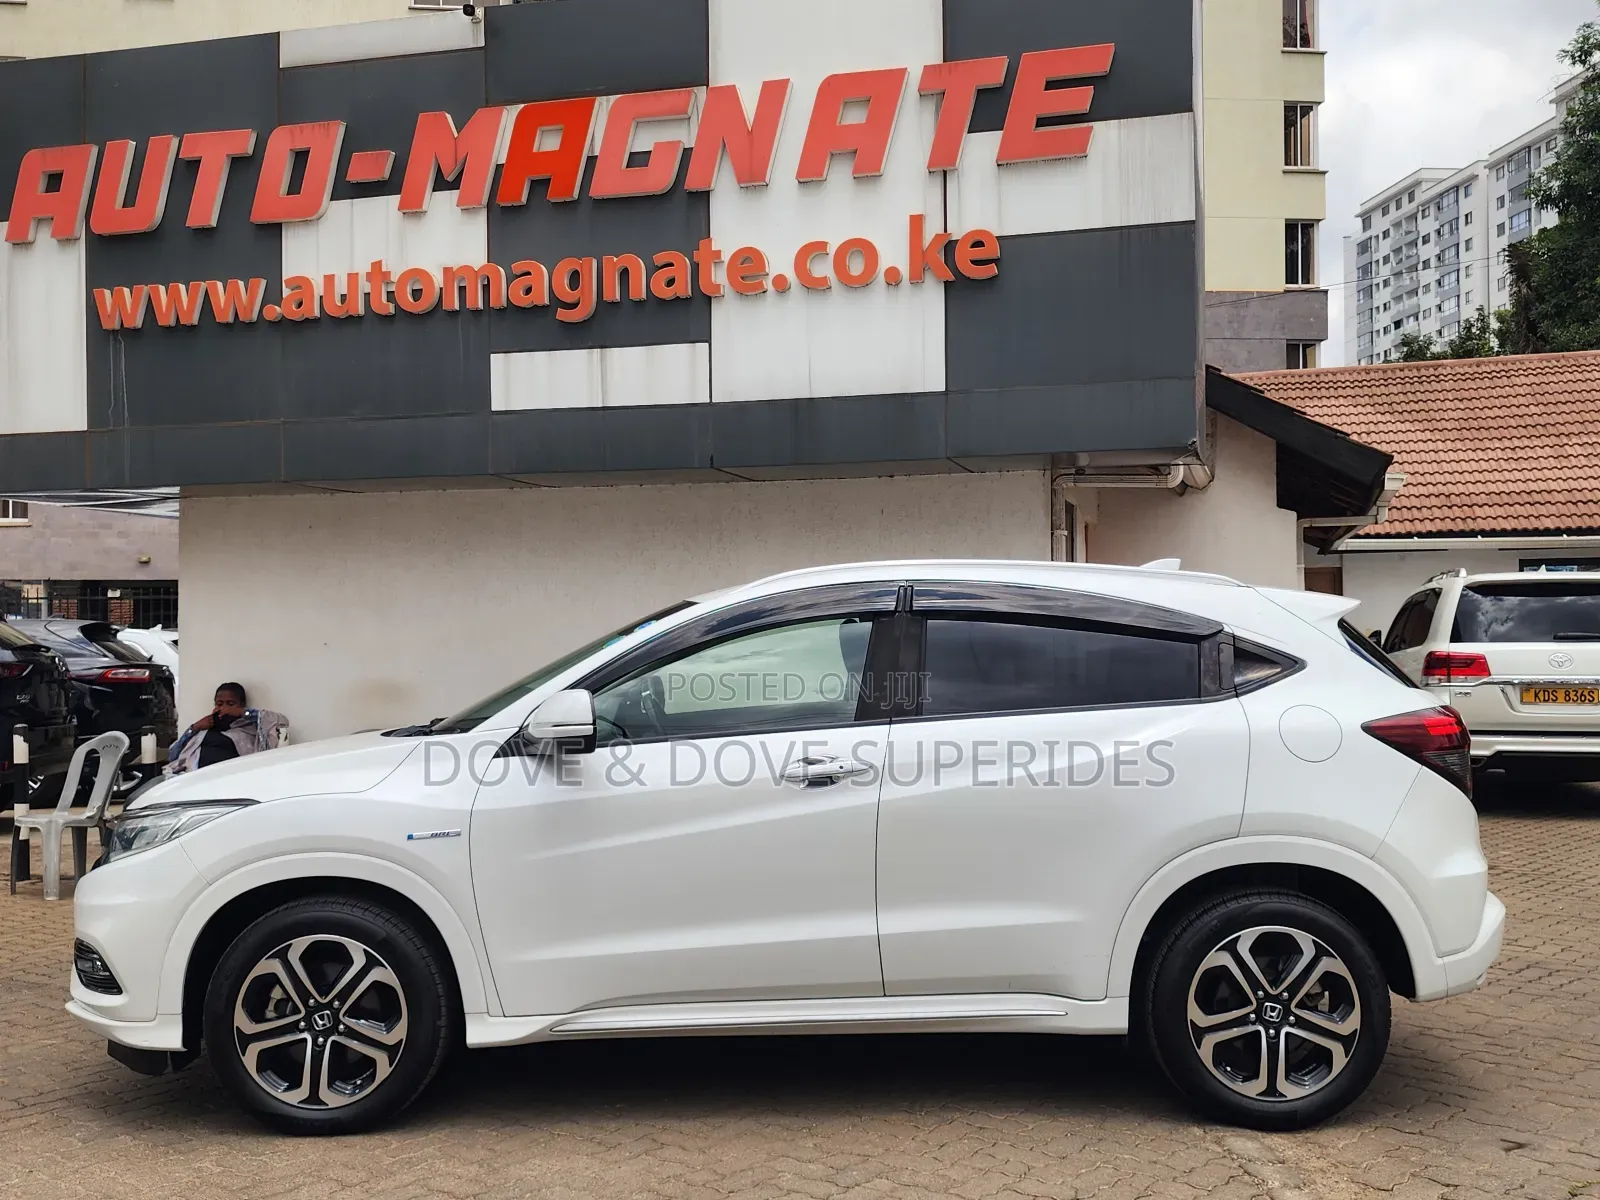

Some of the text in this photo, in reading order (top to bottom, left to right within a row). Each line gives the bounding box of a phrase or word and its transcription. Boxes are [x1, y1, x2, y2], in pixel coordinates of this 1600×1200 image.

[5, 43, 1115, 243] AUTO-MAGNATE
[93, 214, 1000, 331] www.automagnate.co.ke
[1534, 690, 1595, 702] KDS 836S
